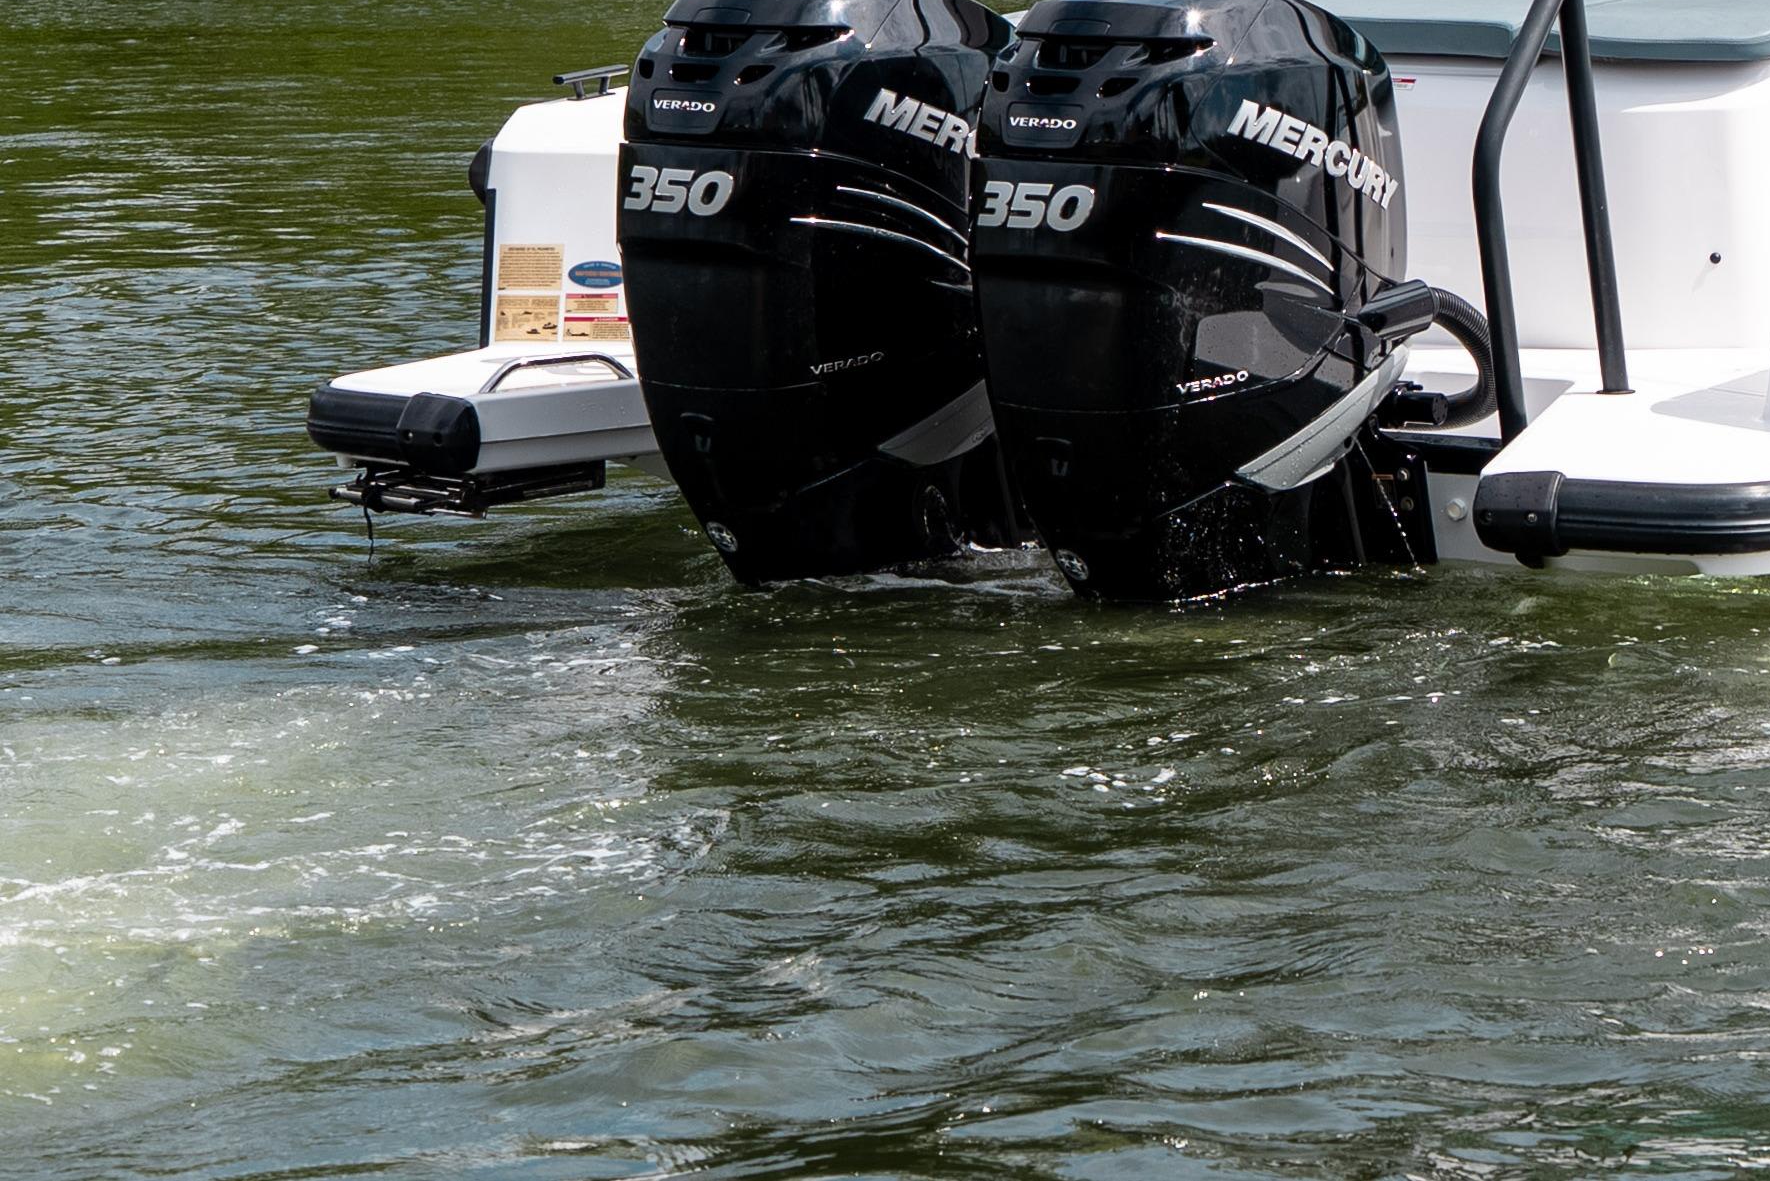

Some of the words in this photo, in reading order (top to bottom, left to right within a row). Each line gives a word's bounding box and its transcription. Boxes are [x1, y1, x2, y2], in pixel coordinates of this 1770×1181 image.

[653, 98, 715, 114] VERADO
[1009, 116, 1077, 131] VERADO
[1227, 99, 1398, 210] MERCURY
[624, 165, 733, 217] 350
[977, 181, 1095, 232] 350
[810, 350, 886, 376] VERADO
[1176, 370, 1249, 395] VERADO
